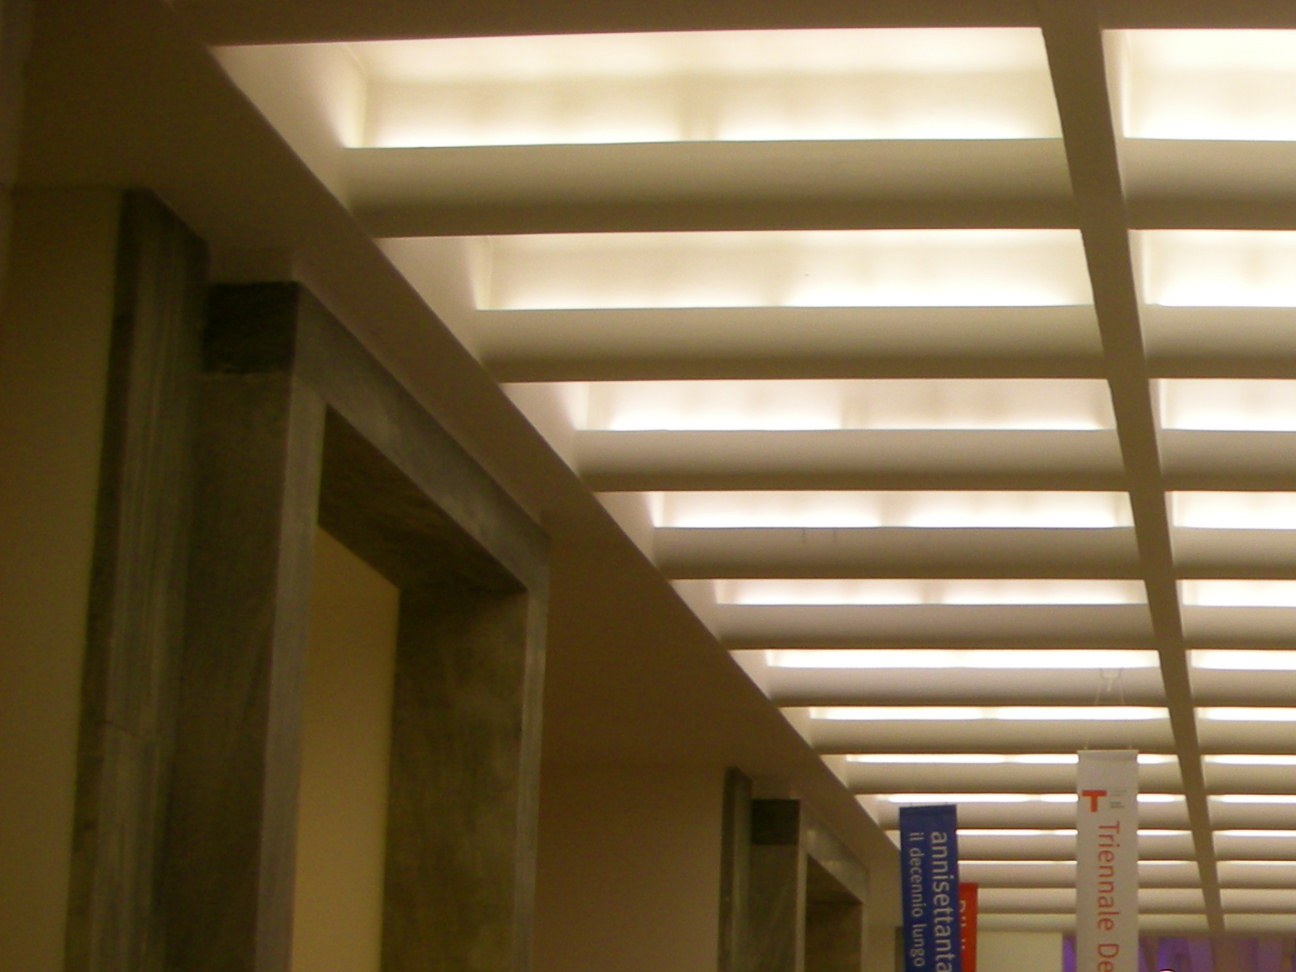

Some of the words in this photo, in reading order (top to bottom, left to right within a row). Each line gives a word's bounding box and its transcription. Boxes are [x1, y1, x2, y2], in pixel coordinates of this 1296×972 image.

[909, 831, 925, 842] il
[909, 847, 927, 918] decennio
[1097, 820, 1121, 932] Triennale
[910, 923, 928, 968] lungo
